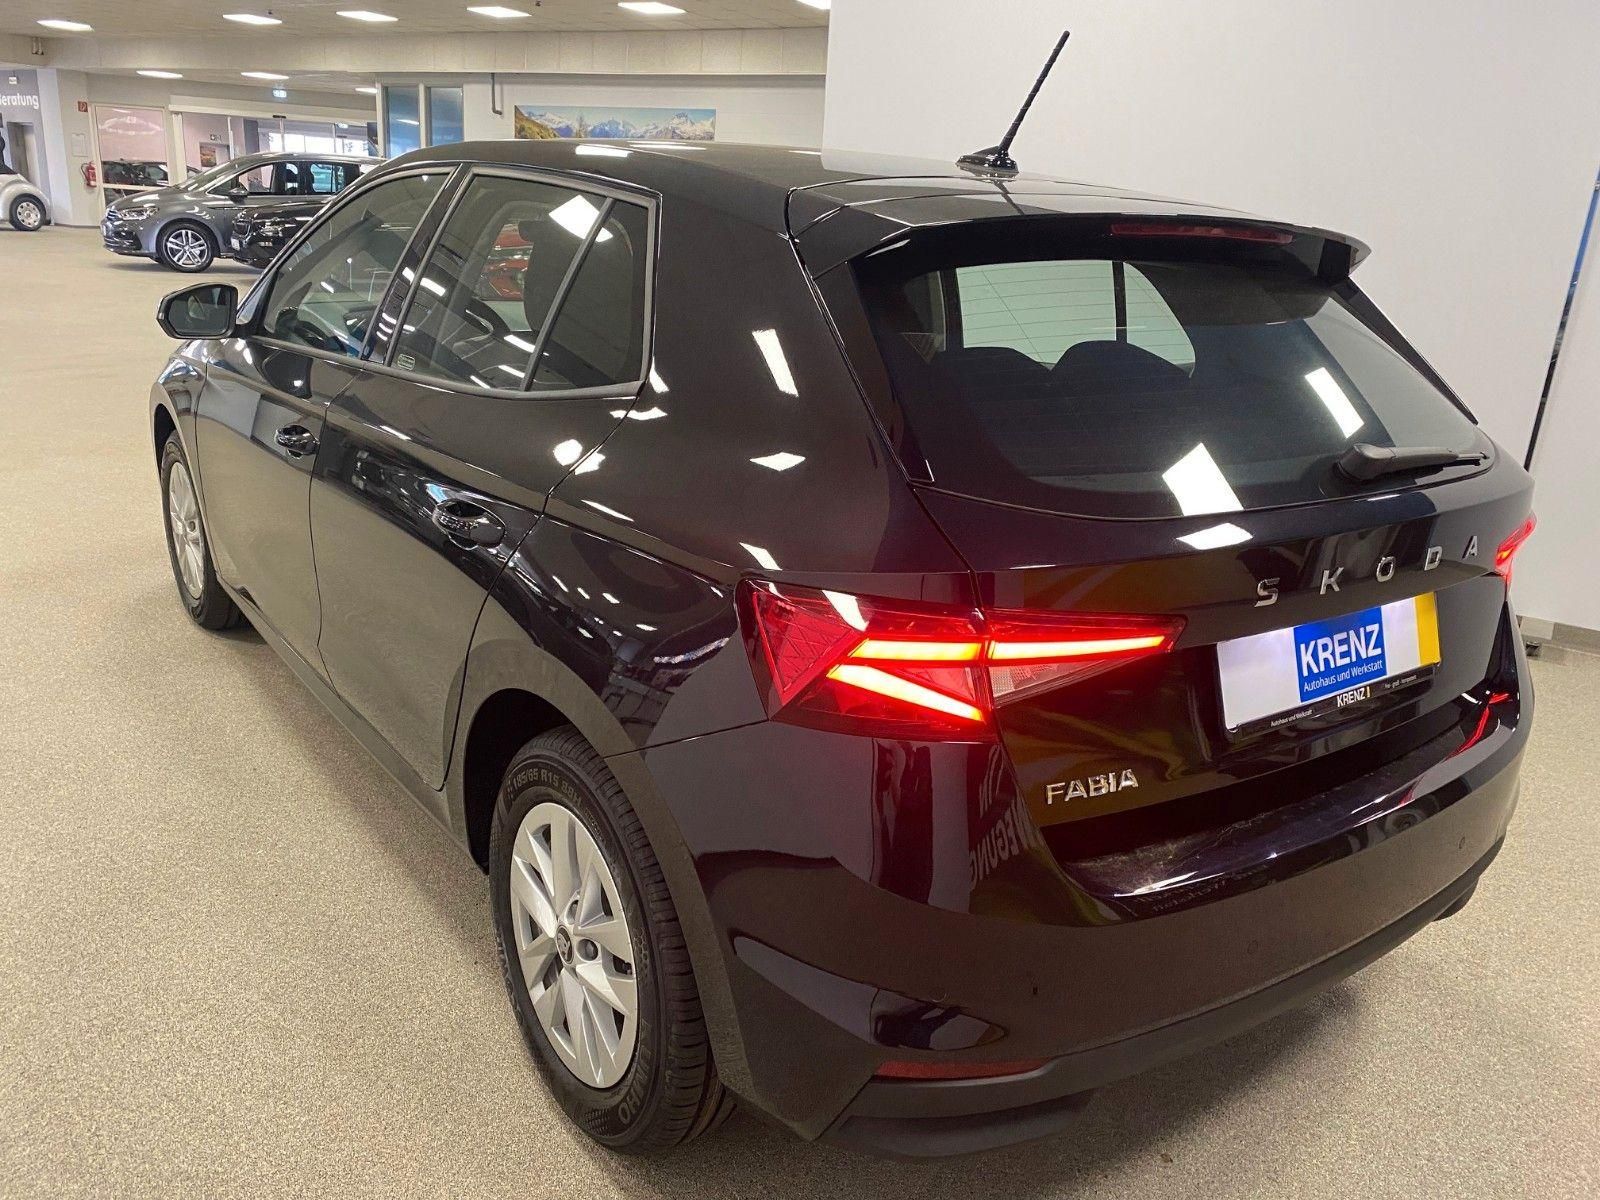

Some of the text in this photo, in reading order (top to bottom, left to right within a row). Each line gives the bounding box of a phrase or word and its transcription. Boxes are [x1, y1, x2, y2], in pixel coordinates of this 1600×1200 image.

[0, 93, 39, 110] eratung
[1300, 623, 1382, 677] KRENZ
[1304, 660, 1383, 692] Autohaus und Werkstatt
[1337, 689, 1366, 707] KRENZ
[541, 769, 559, 787] R15
[1046, 768, 1139, 804] FABIA
